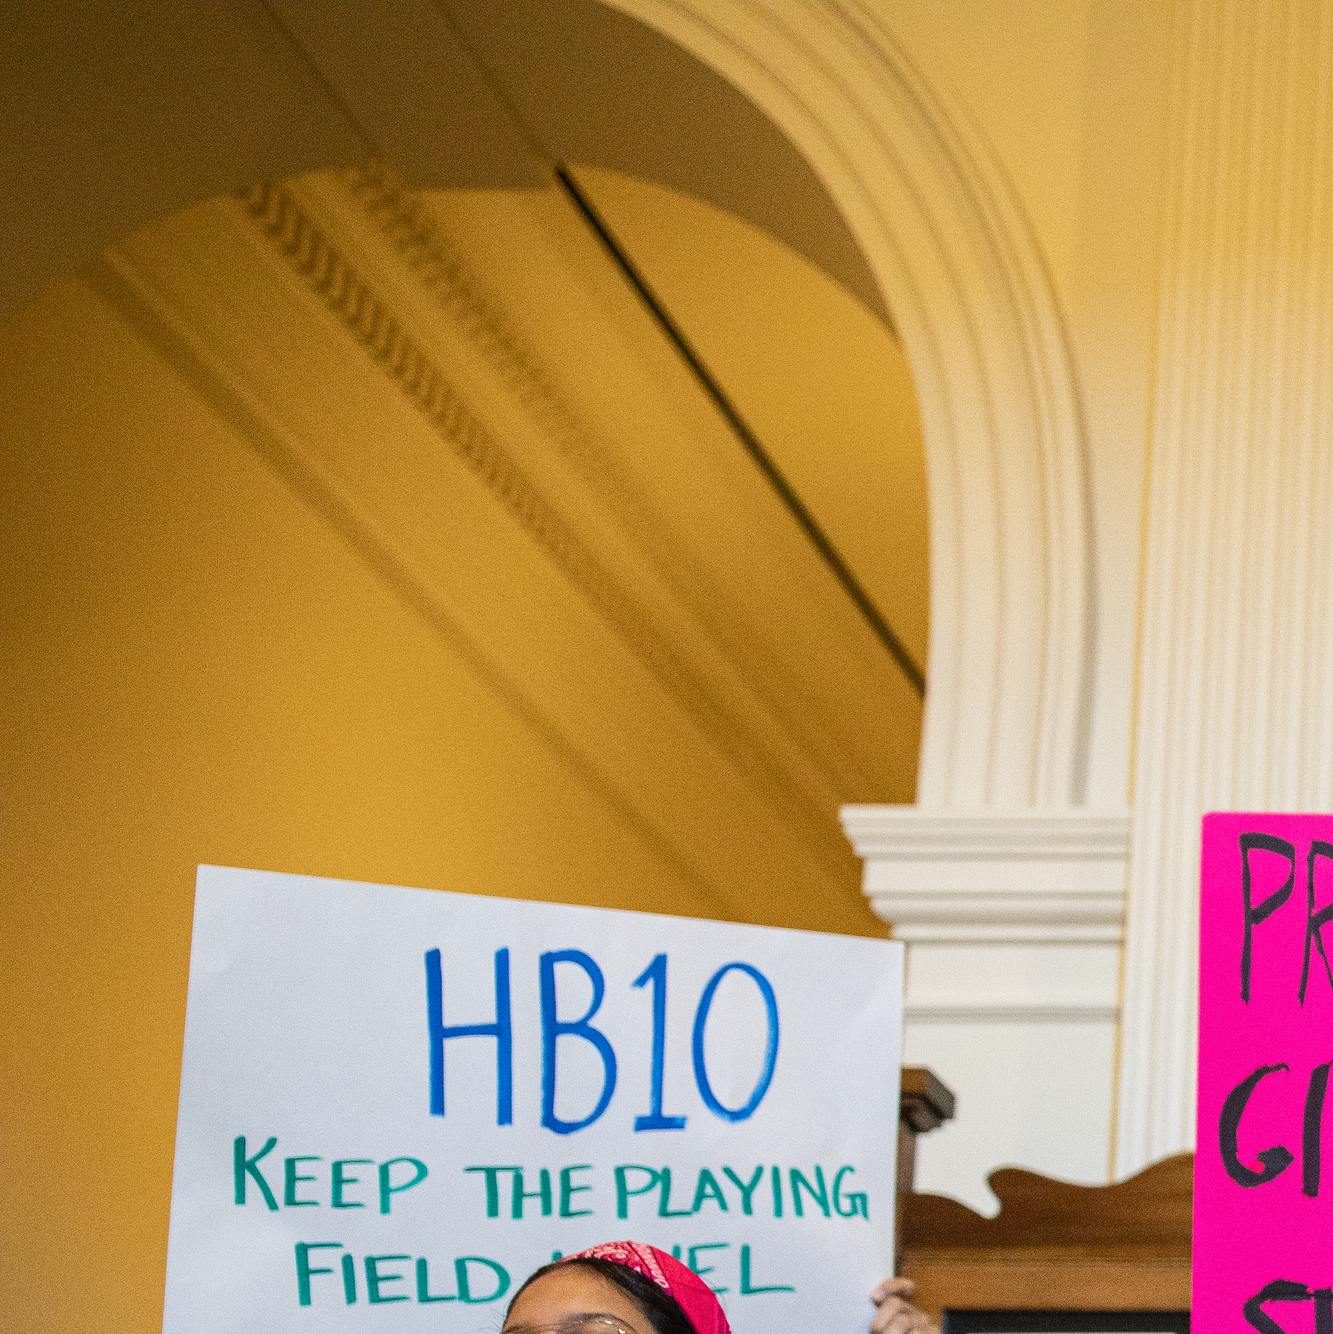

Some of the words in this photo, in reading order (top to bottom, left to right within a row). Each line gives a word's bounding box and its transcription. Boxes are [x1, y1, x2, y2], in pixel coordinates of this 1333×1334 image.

[424, 946, 780, 1136] HB10
[232, 1135, 430, 1213] KEEP
[464, 1164, 595, 1221] THE
[614, 1164, 870, 1222] PLAYING
[294, 1241, 512, 1307] FIELD
